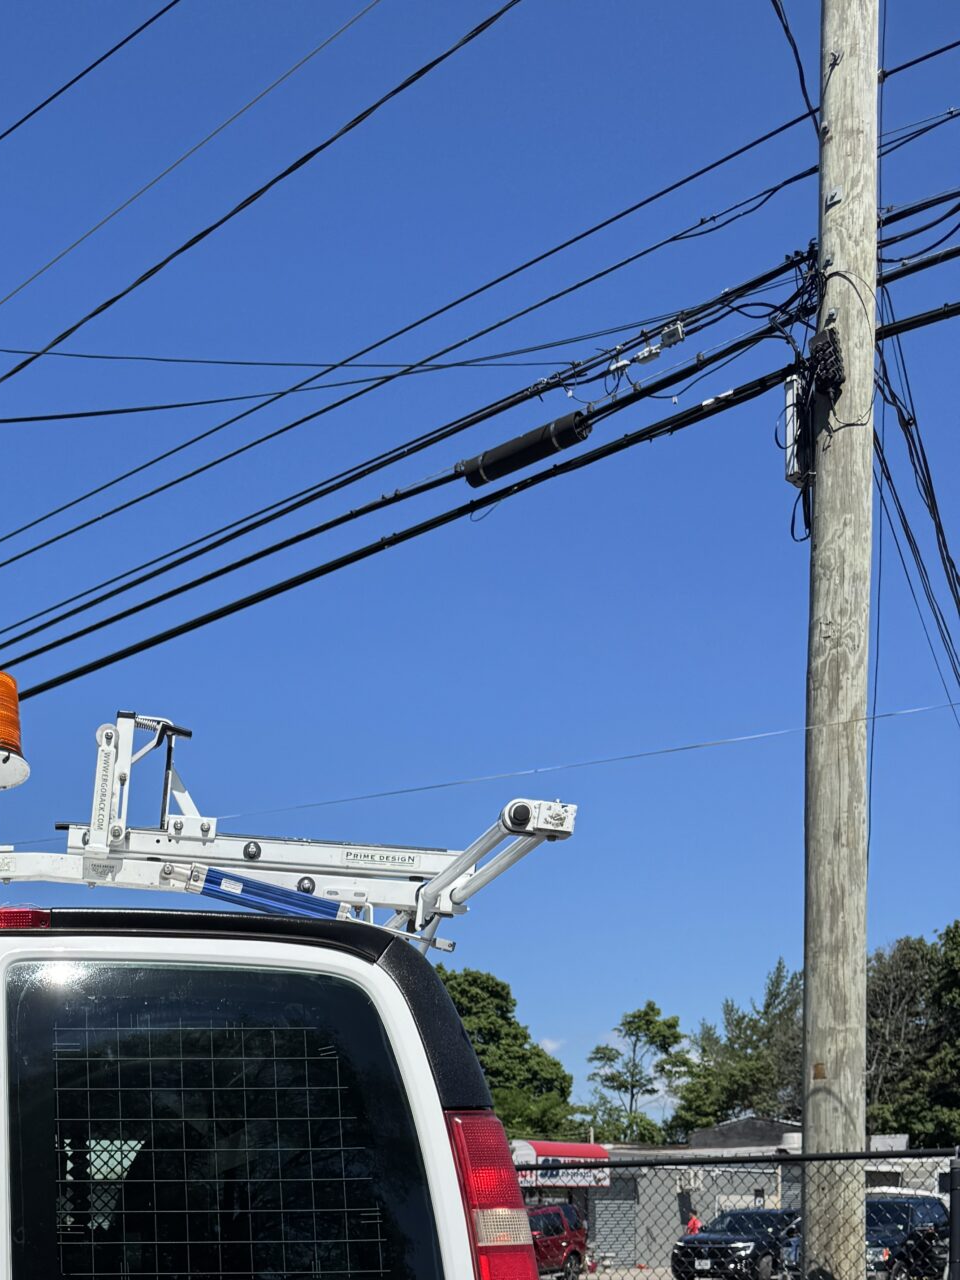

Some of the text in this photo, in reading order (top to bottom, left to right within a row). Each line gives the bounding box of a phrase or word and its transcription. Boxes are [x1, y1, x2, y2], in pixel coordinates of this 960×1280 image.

[97, 752, 111, 830] WWW.ERGORACK.COM
[345, 851, 415, 863] PRIME DESIGN
